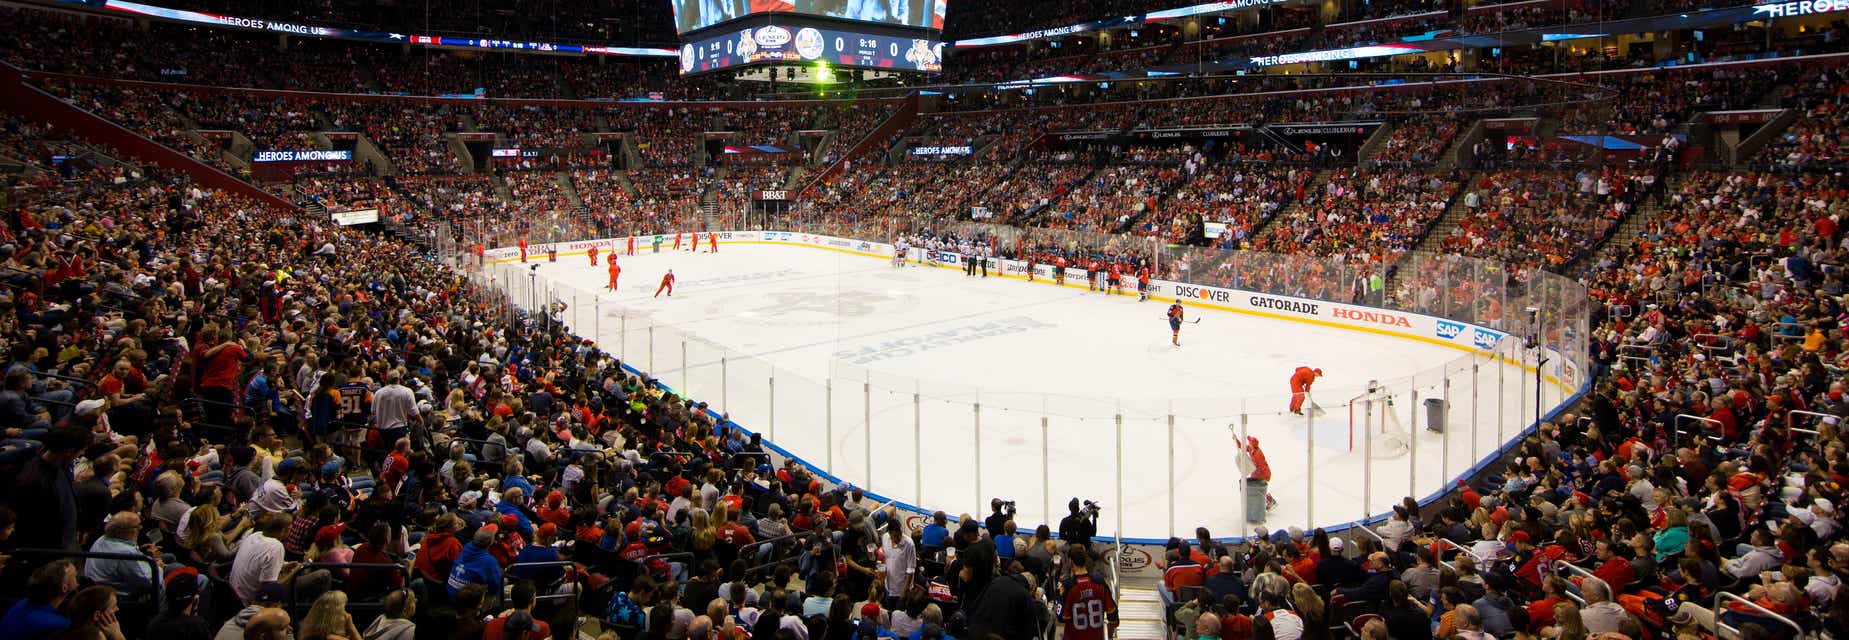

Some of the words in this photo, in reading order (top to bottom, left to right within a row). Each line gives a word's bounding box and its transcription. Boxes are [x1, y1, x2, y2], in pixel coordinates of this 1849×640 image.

[220, 16, 264, 29] HEROES
[267, 22, 307, 33] AMONG
[1018, 30, 1042, 40] HEROES
[1044, 26, 1068, 37] AMONG
[1070, 25, 1080, 33] US
[727, 39, 732, 54] 0
[835, 37, 844, 51] 0
[860, 38, 877, 49] 9:16
[890, 42, 898, 57] 0
[1258, 54, 1299, 66] HEROES
[259, 151, 293, 160] HEROES
[295, 151, 331, 160] AMONG
[762, 191, 787, 200] BB&T
[1176, 285, 1230, 303] DISCOVER
[1250, 296, 1319, 315] GATORADE
[1332, 307, 1412, 328] HONDA
[1438, 322, 1459, 335] SAP
[1475, 331, 1496, 345] SAP
[1072, 600, 1103, 630] 68
